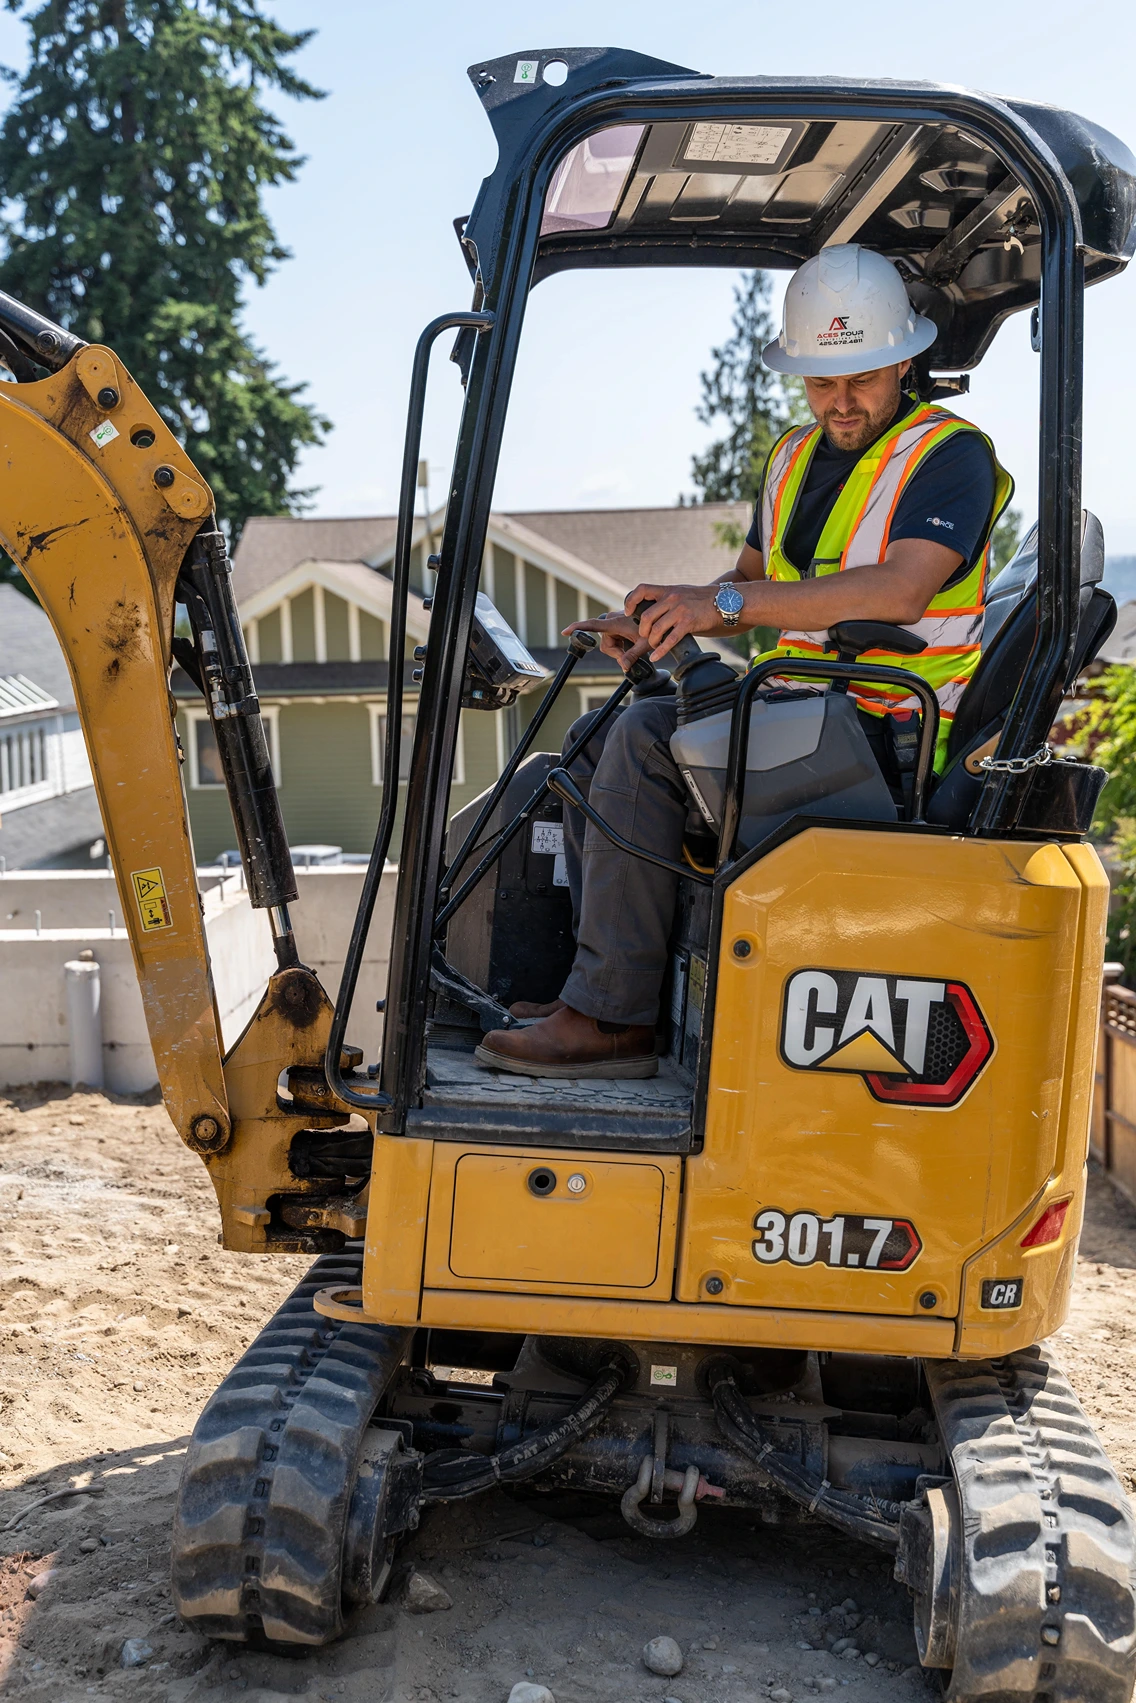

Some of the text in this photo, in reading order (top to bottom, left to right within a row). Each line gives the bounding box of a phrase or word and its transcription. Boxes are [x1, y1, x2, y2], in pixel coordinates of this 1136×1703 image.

[784, 971, 946, 1075] CAT
[755, 1211, 893, 1267] 301.7
[990, 1283, 1018, 1305] CR
[513, 1444, 539, 1464] CAT
